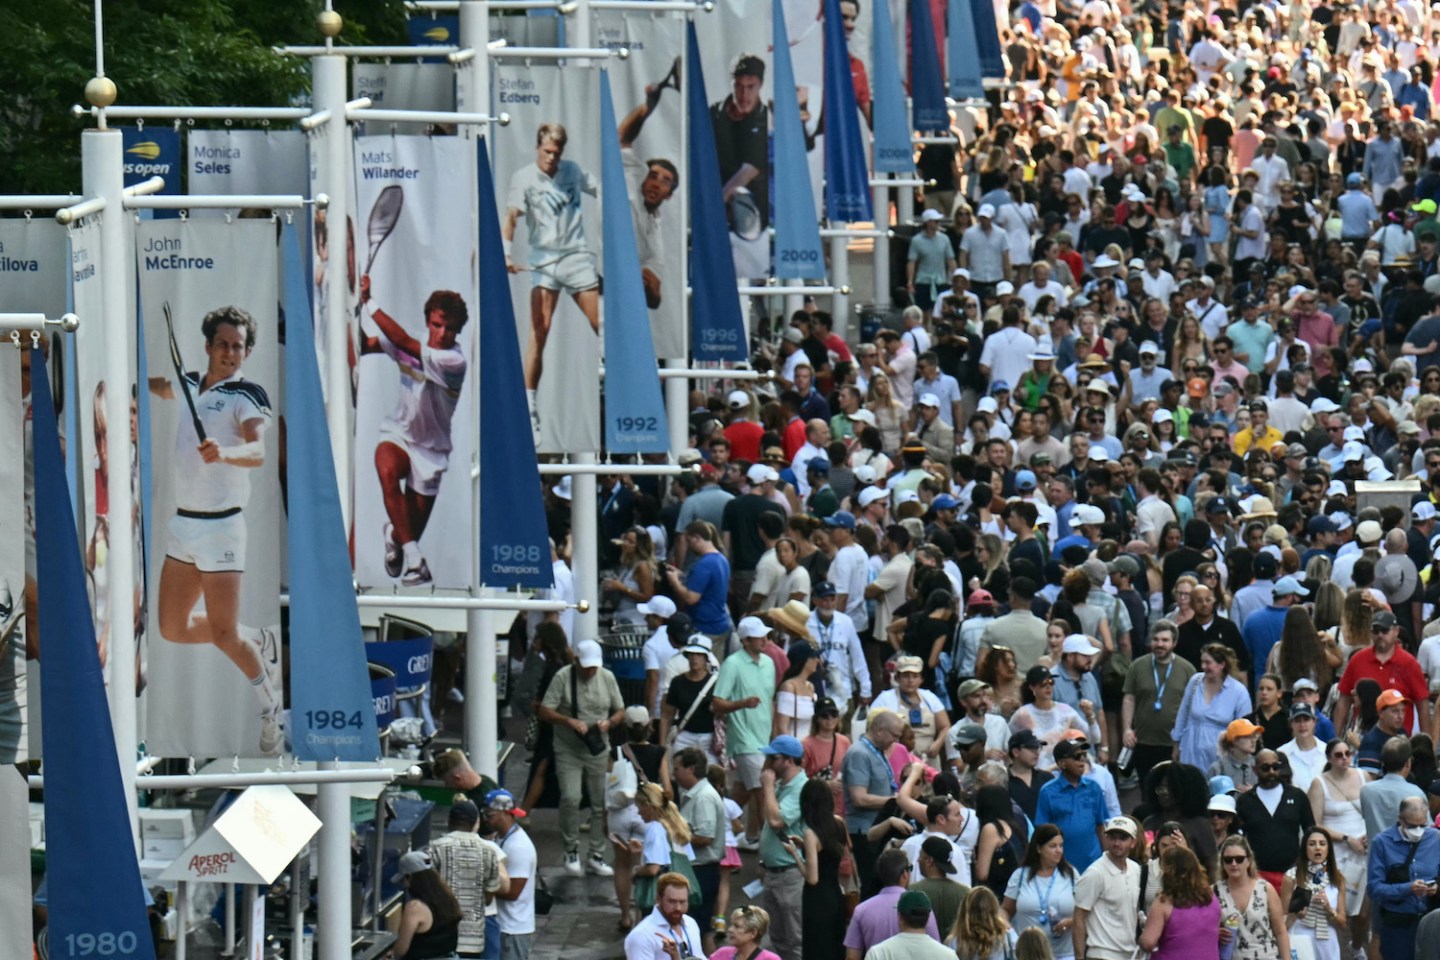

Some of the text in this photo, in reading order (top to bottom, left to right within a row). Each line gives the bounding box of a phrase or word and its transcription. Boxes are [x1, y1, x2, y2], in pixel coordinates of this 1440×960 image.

[499, 79, 535, 90] Stefan
[499, 92, 541, 105] Edberg
[194, 145, 241, 159] Monica
[362, 151, 392, 164] Mats
[194, 161, 232, 175] Seles
[362, 166, 420, 180] Wilander
[144, 237, 182, 252] John
[781, 249, 818, 262] 2000
[145, 256, 214, 271] McEnroe
[700, 328, 738, 343] 1996
[615, 417, 658, 432] 1992
[491, 545, 541, 563] 1988
[491, 563, 540, 575] Champions
[305, 709, 365, 731] 1984
[305, 733, 363, 747] Champions
[188, 852, 238, 874] APEROL
[196, 864, 229, 878] SPRITZ
[65, 931, 138, 957] 1980
